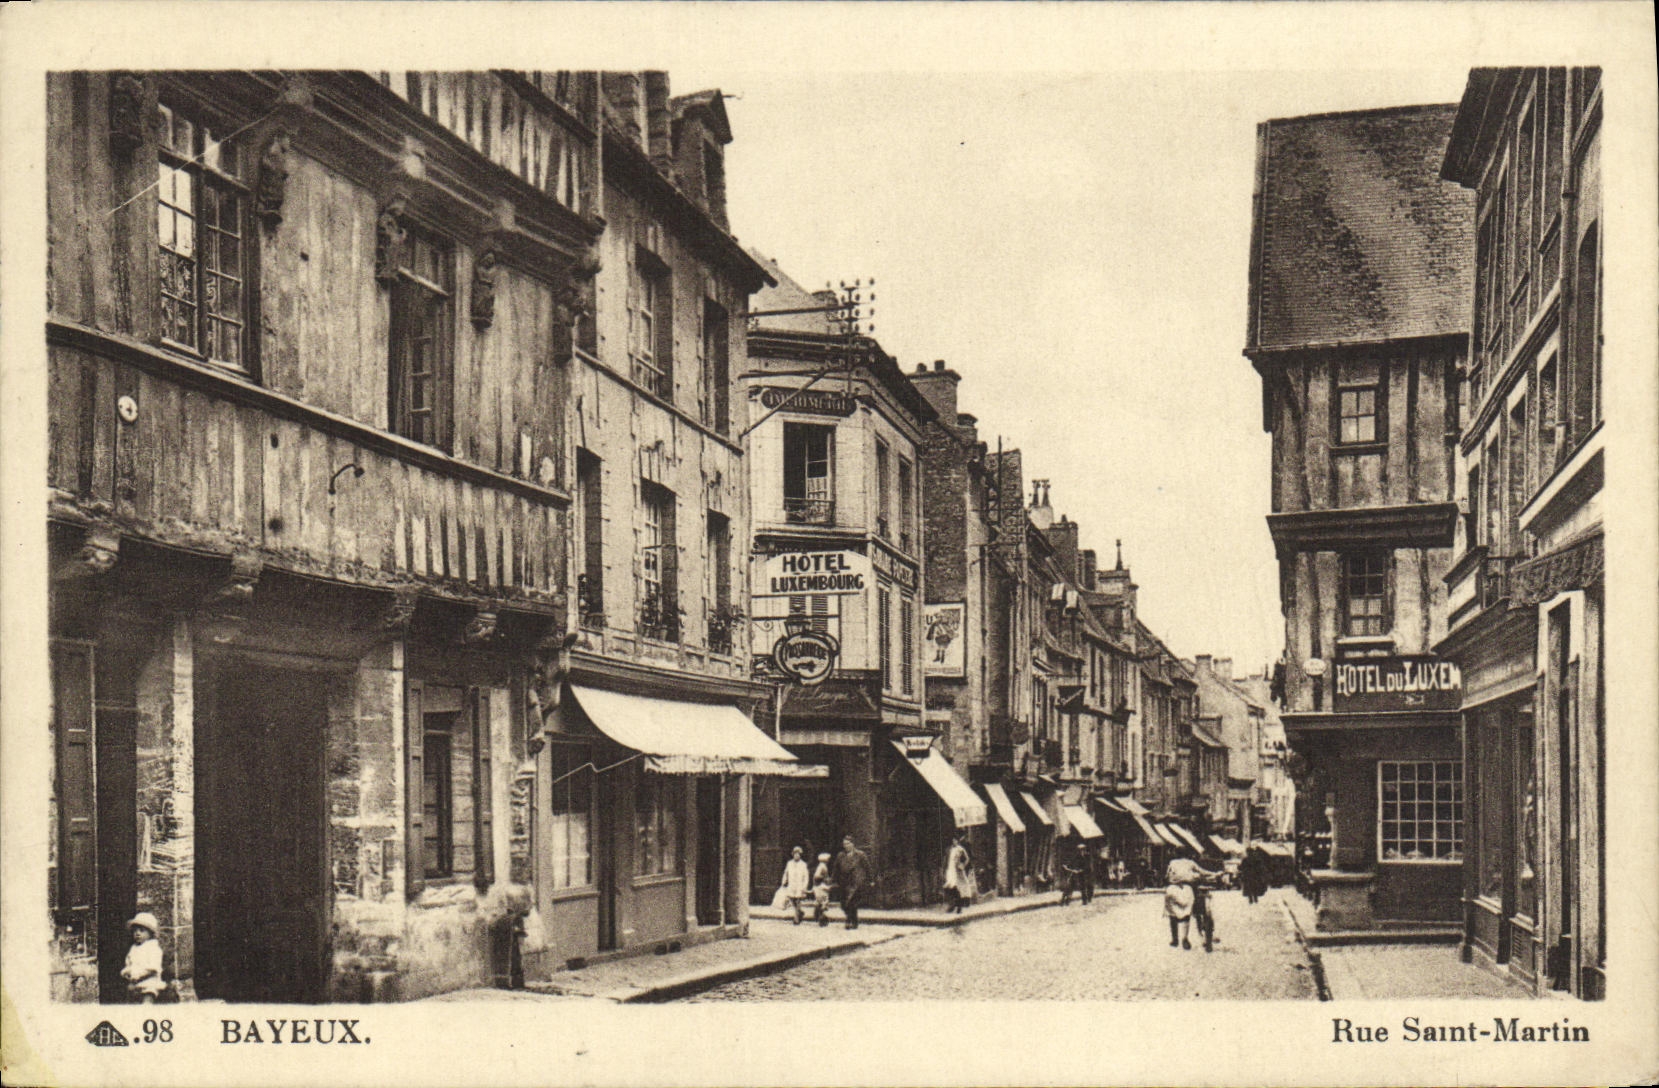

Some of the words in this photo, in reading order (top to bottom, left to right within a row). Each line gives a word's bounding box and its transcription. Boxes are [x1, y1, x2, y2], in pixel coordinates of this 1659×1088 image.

[771, 573, 864, 593] LUXEMBOURG
[1336, 663, 1386, 696] HOTEL
[1386, 672, 1403, 692] DU
